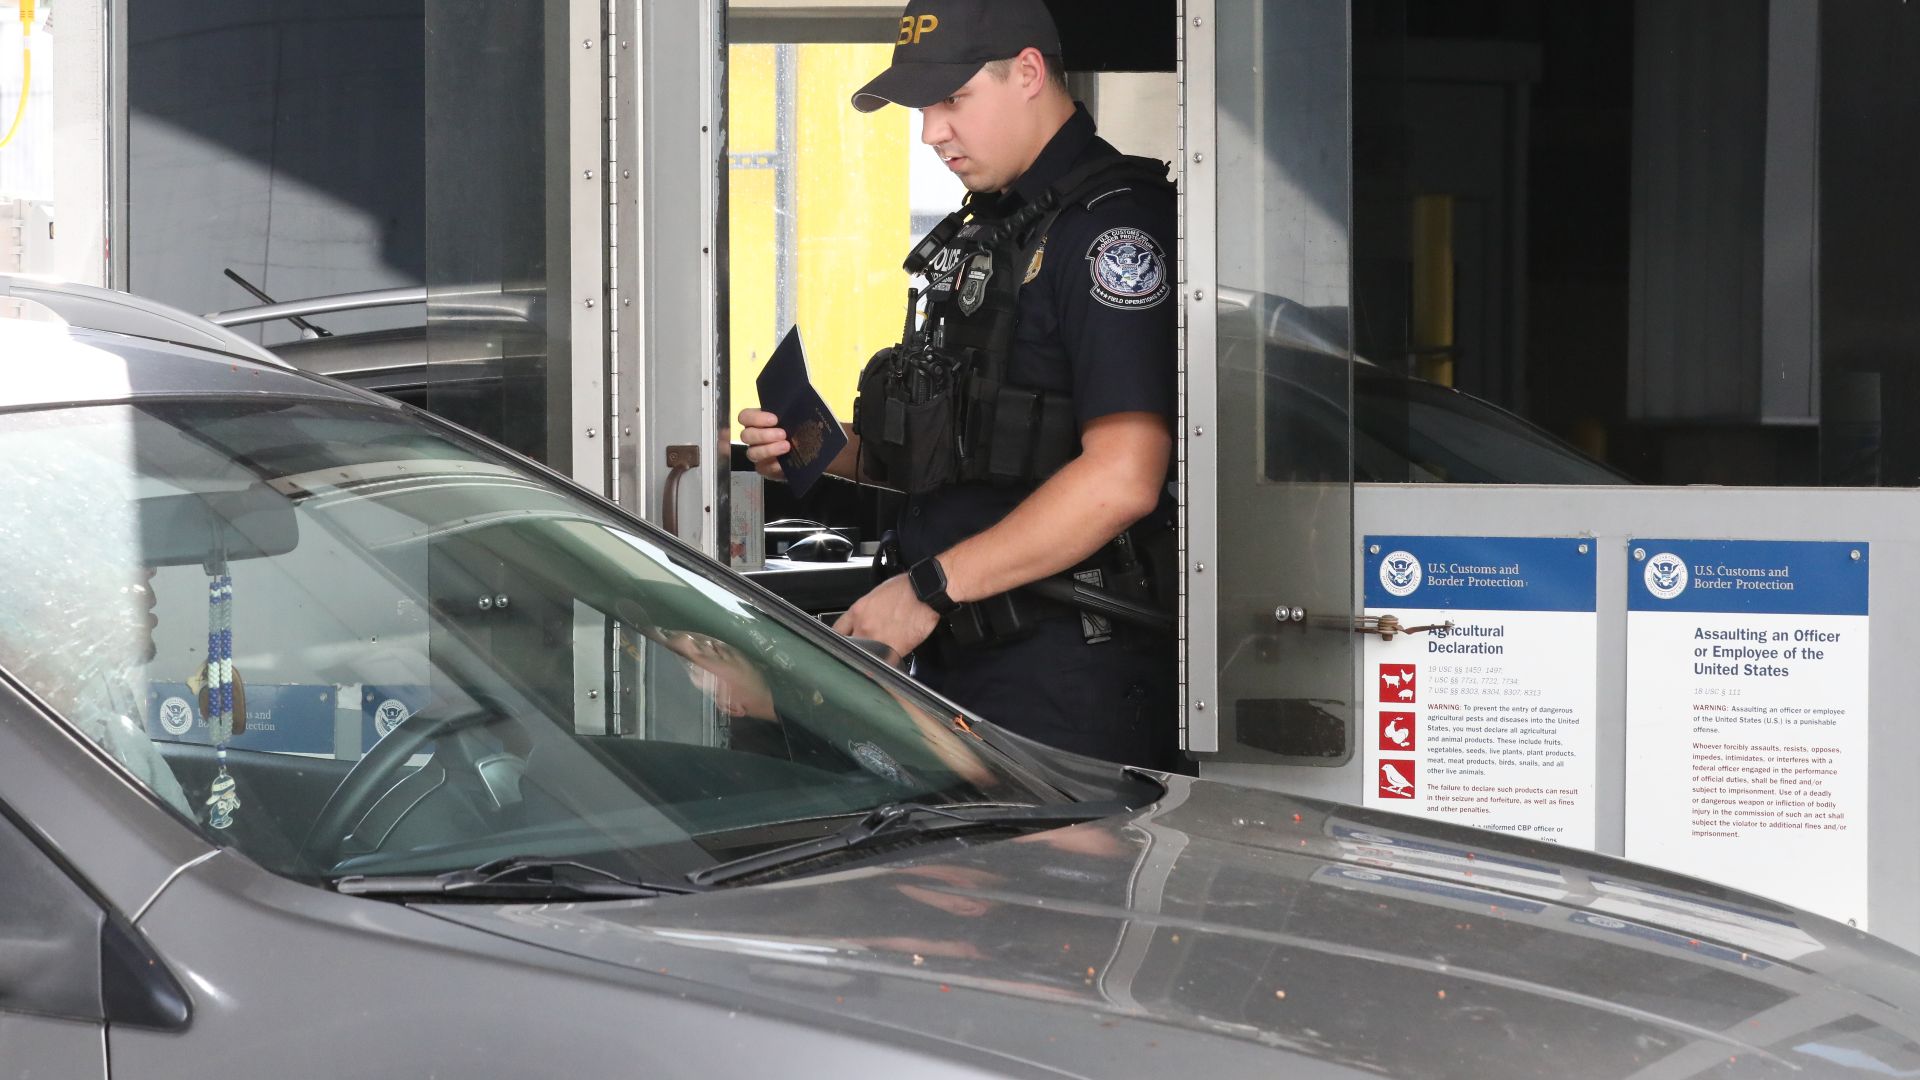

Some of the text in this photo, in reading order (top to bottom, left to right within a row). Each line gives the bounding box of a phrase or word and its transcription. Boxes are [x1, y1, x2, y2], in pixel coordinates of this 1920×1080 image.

[897, 14, 938, 46] BP
[1097, 234, 1154, 251] BORDER PROTECTION
[1108, 294, 1158, 304] FIELD OPERATIONS
[1429, 563, 1520, 574] U.S. Customs and
[1695, 565, 1789, 577] U.S. Customs and
[1428, 576, 1524, 587] Border Protection
[1694, 578, 1794, 590] Border Protection
[1695, 627, 1841, 643] Assaulting an Officer
[1429, 641, 1503, 654] Declaration
[1694, 645, 1824, 661] or Employee of the
[1695, 663, 1789, 676] United States
[255, 710, 271, 719] and
[1731, 706, 1768, 714] Assaulting
[1742, 766, 1771, 774] engaged
[1795, 768, 1838, 776] performance
[1701, 798, 1737, 806] dangerous
[1692, 819, 1717, 827] subject
